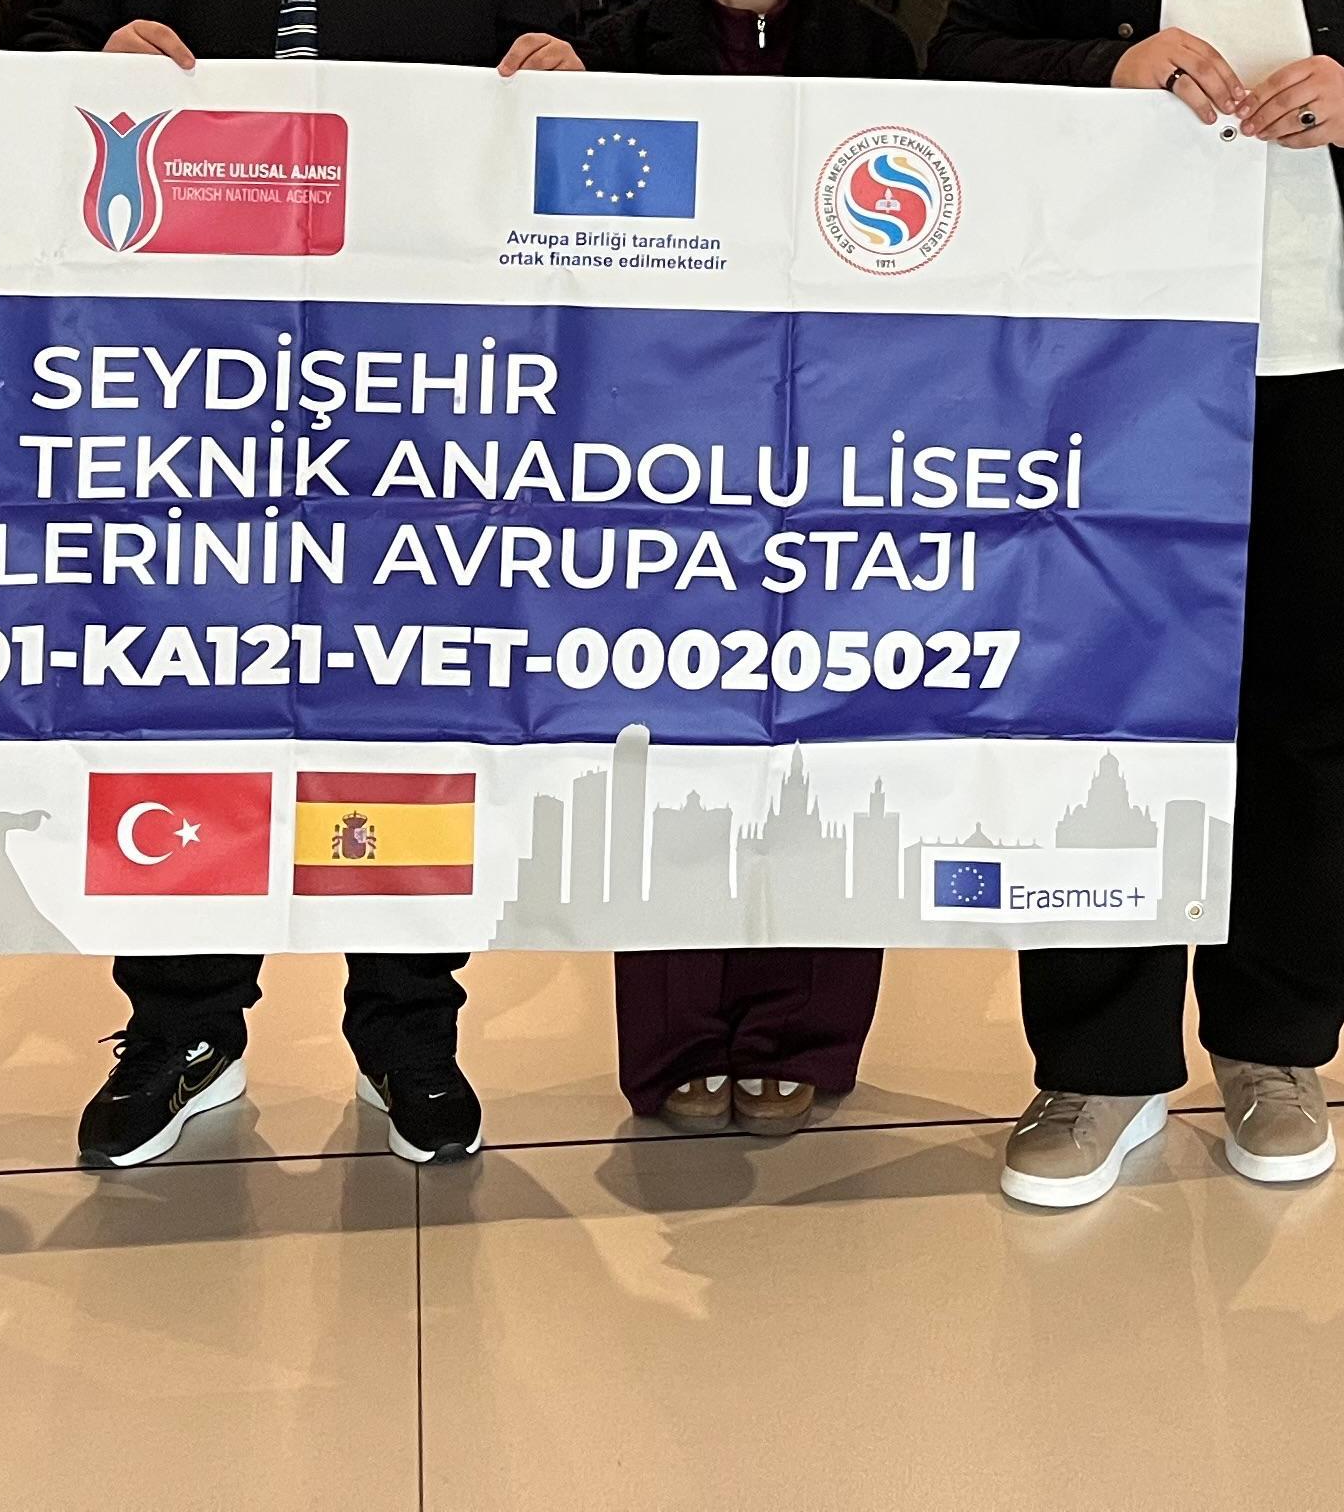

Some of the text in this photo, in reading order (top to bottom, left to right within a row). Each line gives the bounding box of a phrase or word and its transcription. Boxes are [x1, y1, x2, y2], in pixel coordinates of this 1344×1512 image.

[163, 159, 342, 180] TÜRKİYE ULUSAL AJANSI
[828, 139, 870, 184] MESLEKİ
[872, 135, 888, 146] VE
[892, 135, 936, 161] TEKNİK
[932, 160, 954, 219] ANADOLU
[171, 186, 332, 204] TURKISH NATIONAL AGENCY
[499, 251, 728, 270] ortak finanse edilmektedir
[507, 230, 721, 251] Avrupa Birliği tarafından
[31, 332, 560, 431] SEYDİŞEHİR
[18, 419, 351, 499] TEKNİK
[371, 439, 811, 510] ANADOLU
[842, 429, 1084, 510] LİSESİ
[373, 523, 737, 593] AVRUPA
[761, 529, 978, 594] STAJI
